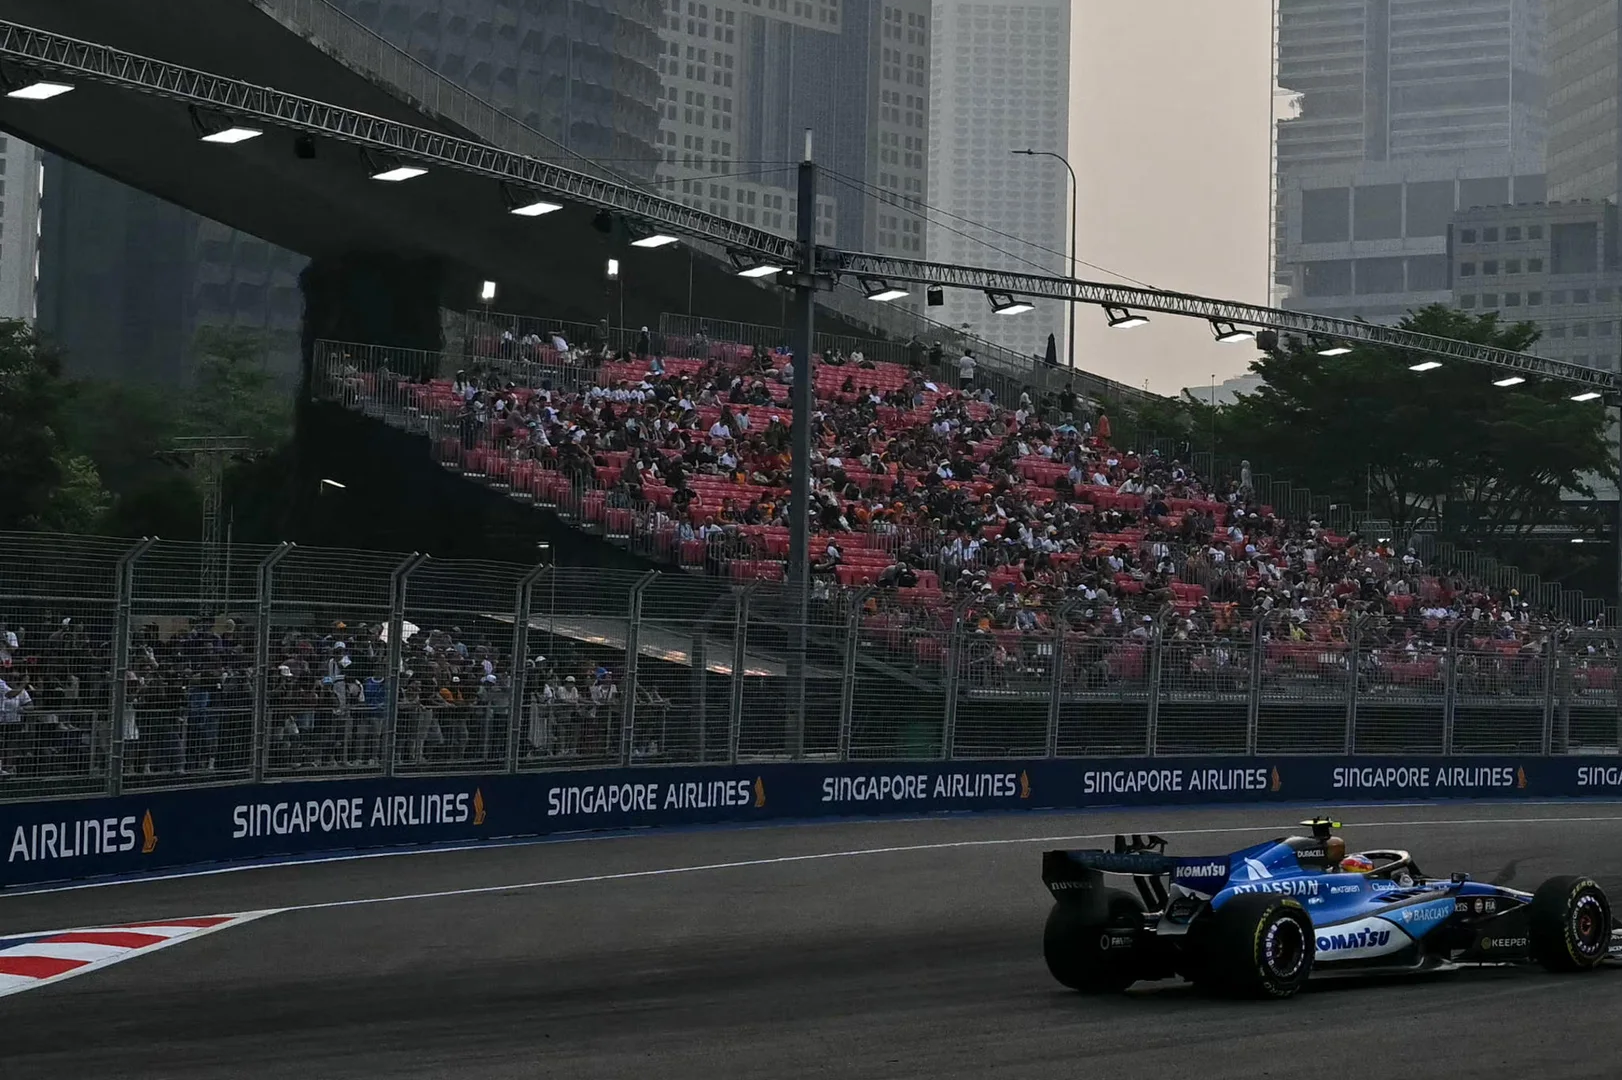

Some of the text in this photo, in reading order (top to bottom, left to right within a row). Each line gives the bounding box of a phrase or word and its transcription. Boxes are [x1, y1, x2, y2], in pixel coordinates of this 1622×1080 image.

[822, 773, 1017, 802] SINGAPORE AIRLINES
[1084, 768, 1267, 793] SINGAPORE AIRLINES
[1334, 767, 1513, 788] SINGAPORE AIRLINES
[548, 780, 750, 816] SINGAPORE AIRLINES
[232, 792, 469, 839] SINGAPORE AIRLINES
[8, 816, 136, 863] AIRLINES
[1297, 849, 1324, 858] DURACELL
[1176, 862, 1226, 877] KOMATSU
[1413, 906, 1450, 921] BARCLAYS
[1315, 927, 1390, 951] OMATSU
[1491, 938, 1527, 948] KEEPER
